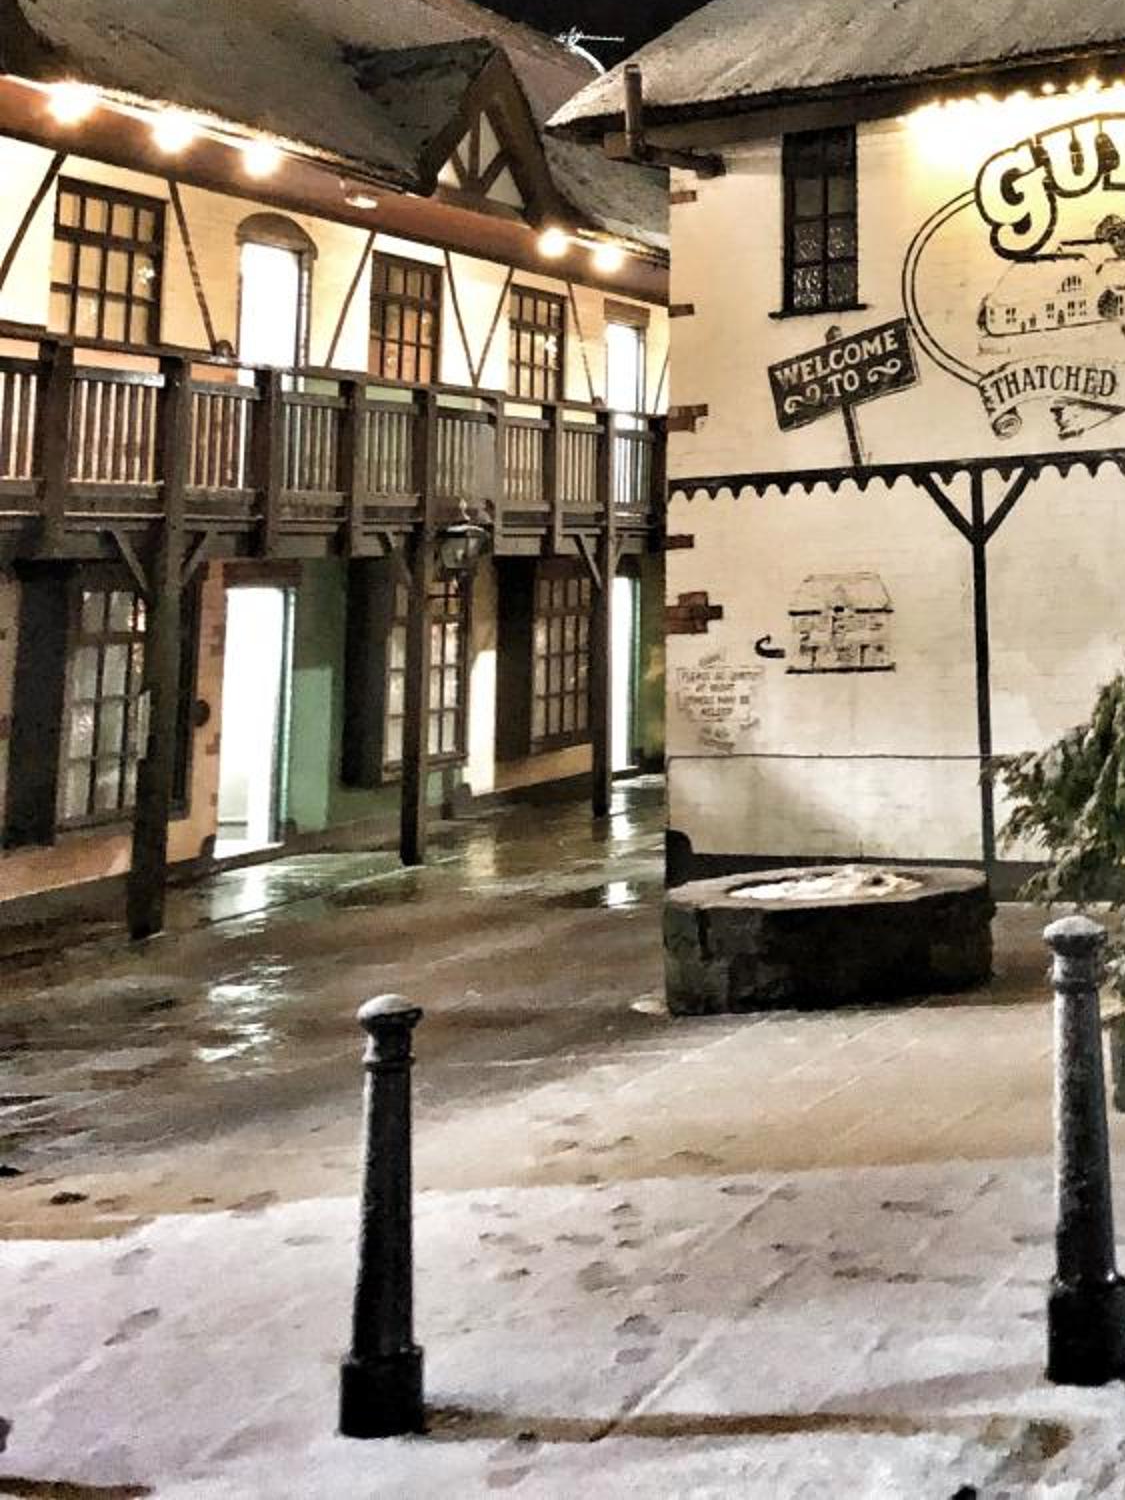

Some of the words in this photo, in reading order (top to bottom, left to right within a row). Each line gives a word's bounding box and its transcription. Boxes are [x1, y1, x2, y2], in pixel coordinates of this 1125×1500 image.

[774, 329, 899, 389] WELCOME
[827, 369, 860, 397] TO
[990, 365, 1117, 404] THATCHED
